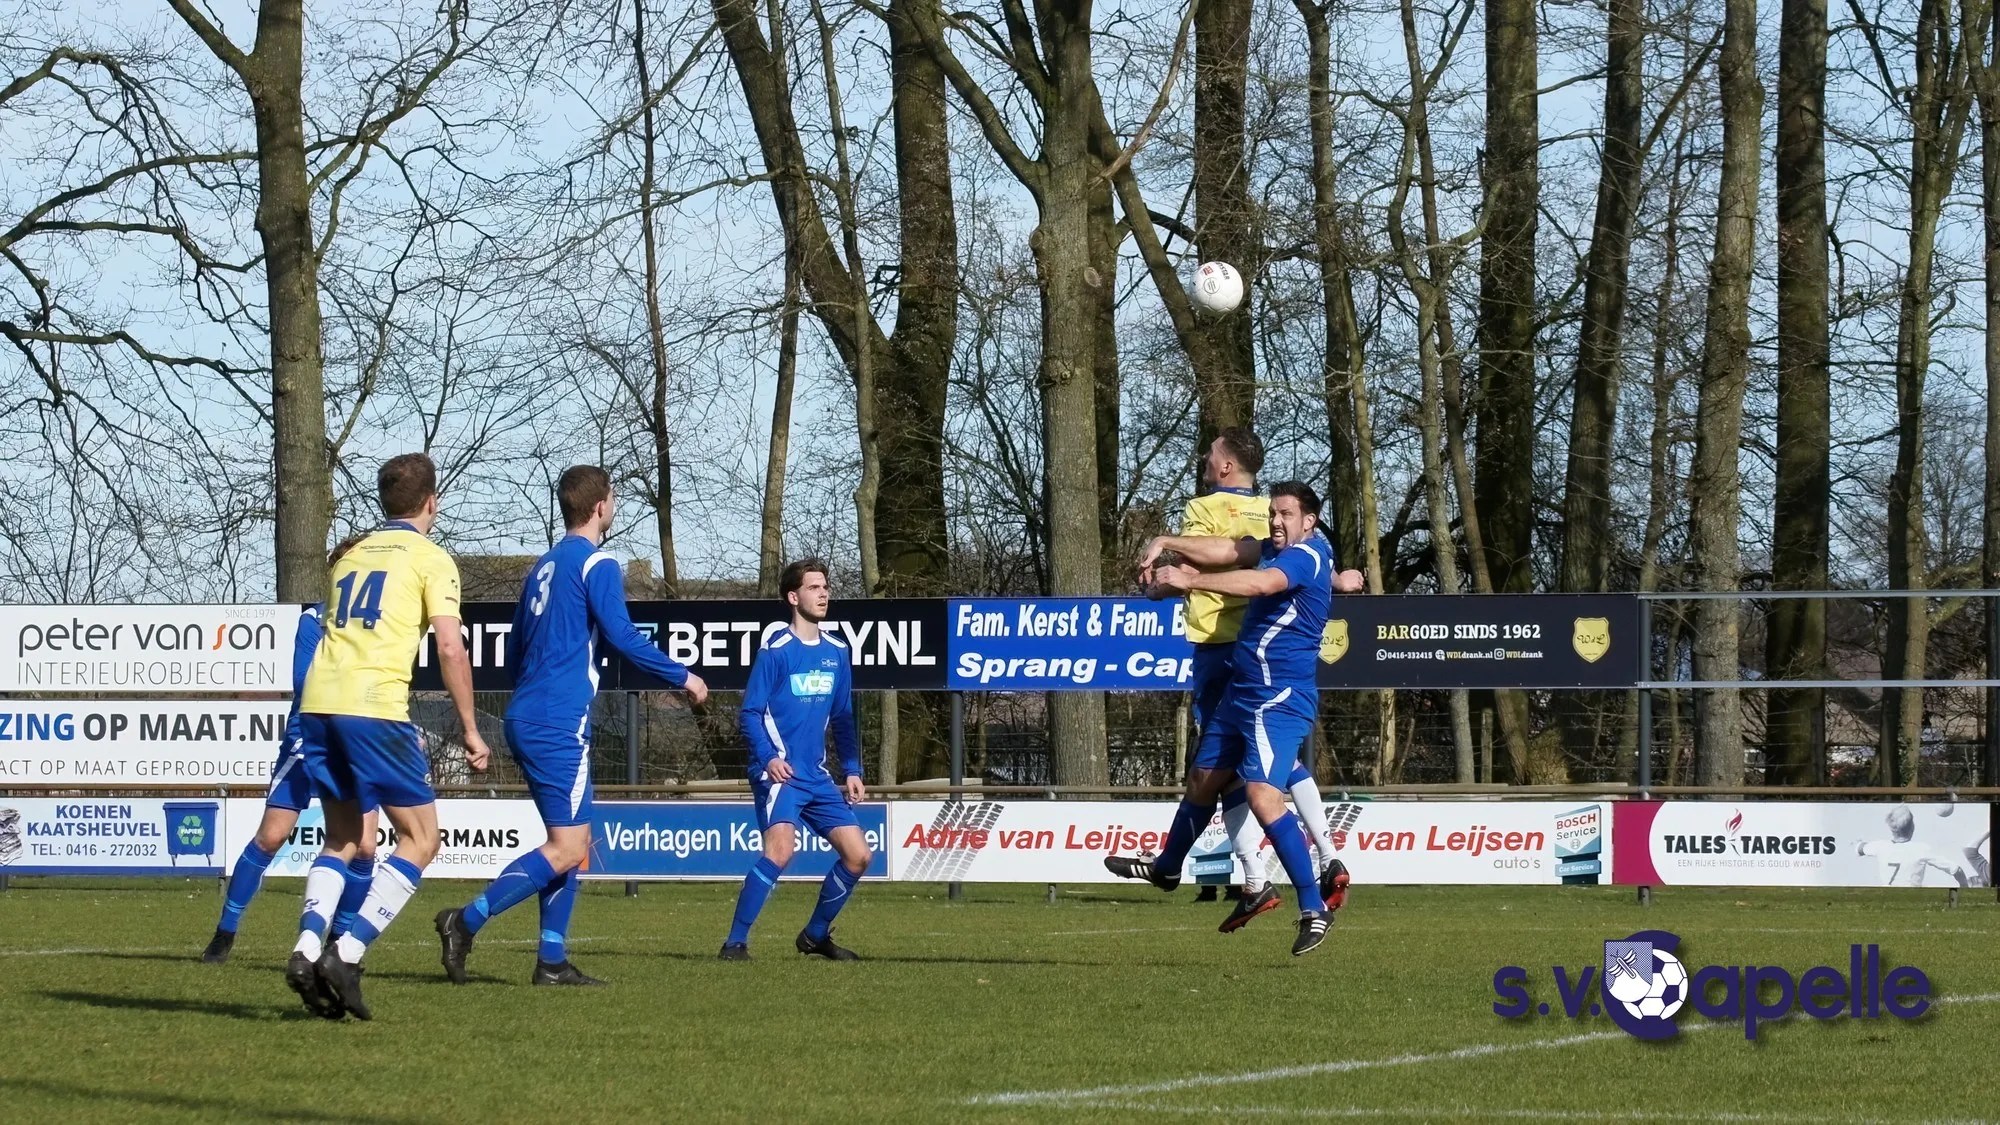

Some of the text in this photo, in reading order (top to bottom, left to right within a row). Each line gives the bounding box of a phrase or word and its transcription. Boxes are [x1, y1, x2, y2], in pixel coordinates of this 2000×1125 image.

[531, 561, 556, 616] 3
[335, 571, 387, 629] 14
[225, 609, 276, 618] SINCE 1979
[956, 604, 1010, 637] Fam.
[1017, 604, 1080, 637] Kerst
[1087, 604, 1102, 636] &
[1110, 604, 1164, 637] Fam.
[19, 618, 276, 658] peter van son
[1377, 625, 1541, 639] BARGOED SINDS 1962
[18, 662, 276, 685] INTERIEUROBJECTEN
[956, 652, 1097, 683] Sprang
[83, 713, 128, 741] OP
[40, 760, 66, 775] OP
[74, 760, 127, 775] MAAT
[56, 805, 132, 819] KOENEN
[1556, 813, 1597, 830] BOSCH
[27, 822, 161, 837] KAATSHEUVEL
[903, 824, 989, 850] Adrie
[999, 830, 1055, 850] van
[1556, 826, 1597, 840] Service
[604, 822, 721, 858] Verhagen
[1357, 830, 1415, 851] van
[1426, 825, 1544, 857] Leijsen
[1664, 835, 1836, 855] TALES TARGETS
[31, 844, 61, 856] TEL:
[66, 844, 97, 856] 0416
[110, 844, 157, 857] 272032
[1493, 856, 1541, 869] auto's
[1571, 864, 1594, 872] Service
[1677, 859, 1822, 868] EEN RIJKE HISTORIE IS GOUD WAARD
[1888, 863, 1900, 885] 7
